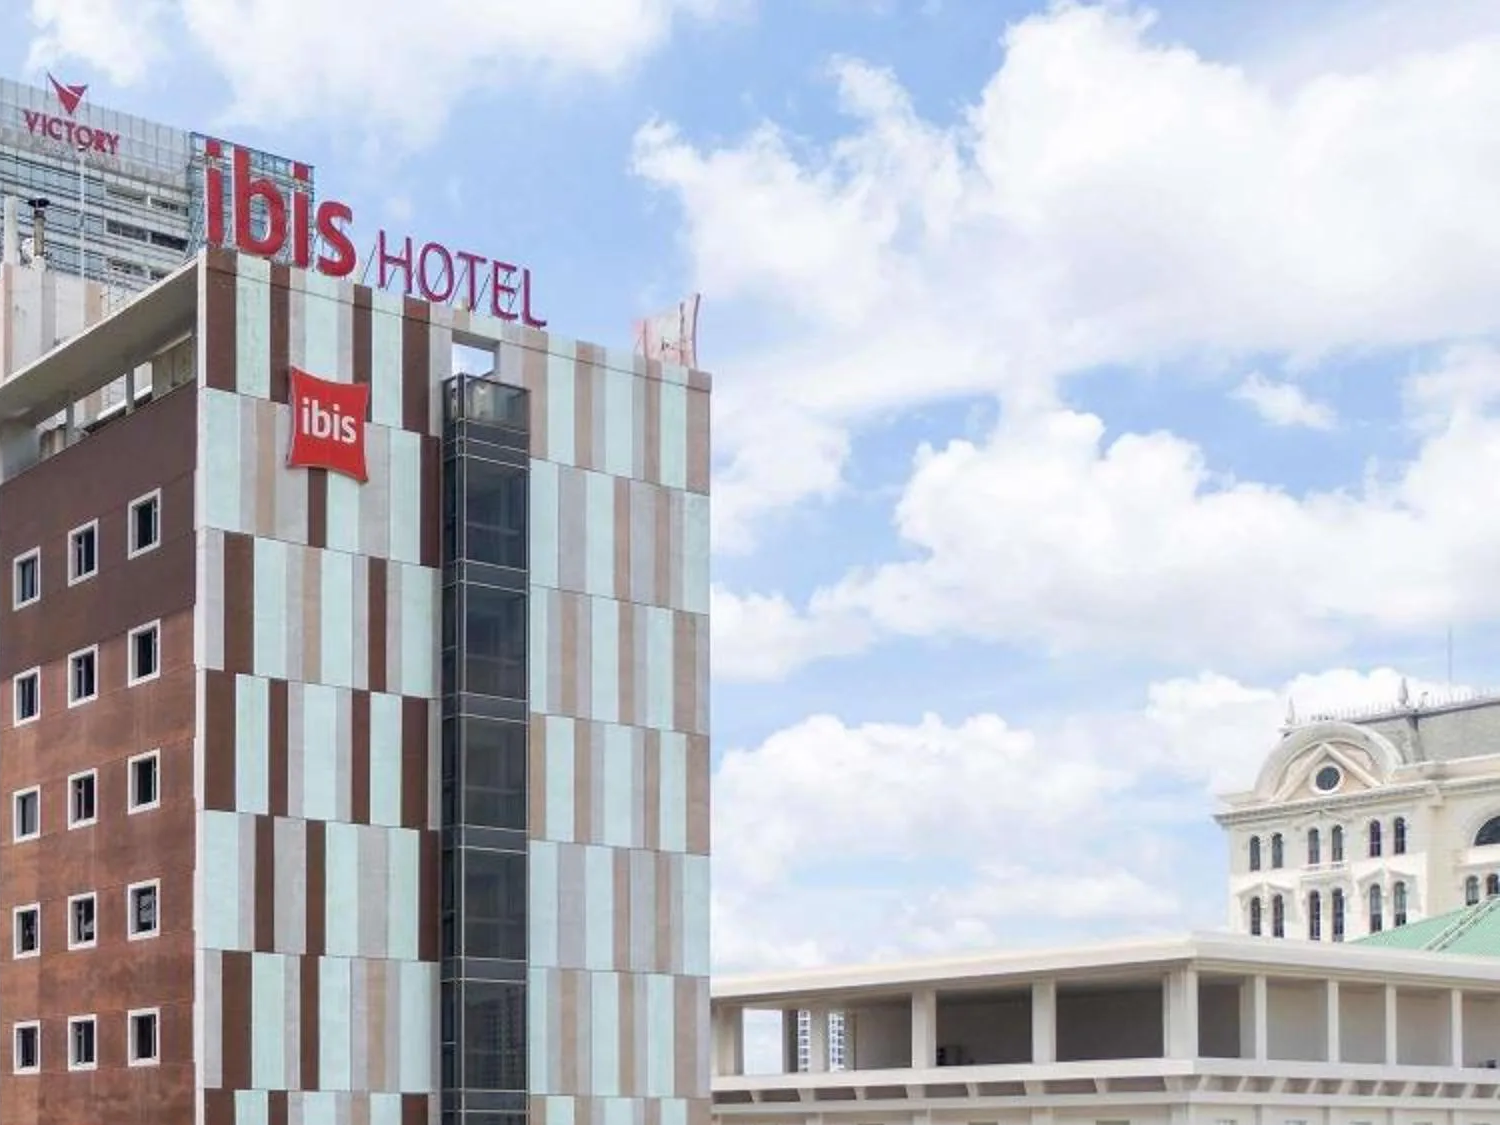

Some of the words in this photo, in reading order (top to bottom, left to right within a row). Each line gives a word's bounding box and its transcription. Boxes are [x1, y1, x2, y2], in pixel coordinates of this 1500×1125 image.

[22, 109, 119, 155] VICTORY
[205, 138, 357, 277] ibis
[375, 229, 547, 329] HOTEL
[302, 396, 357, 444] ibis
